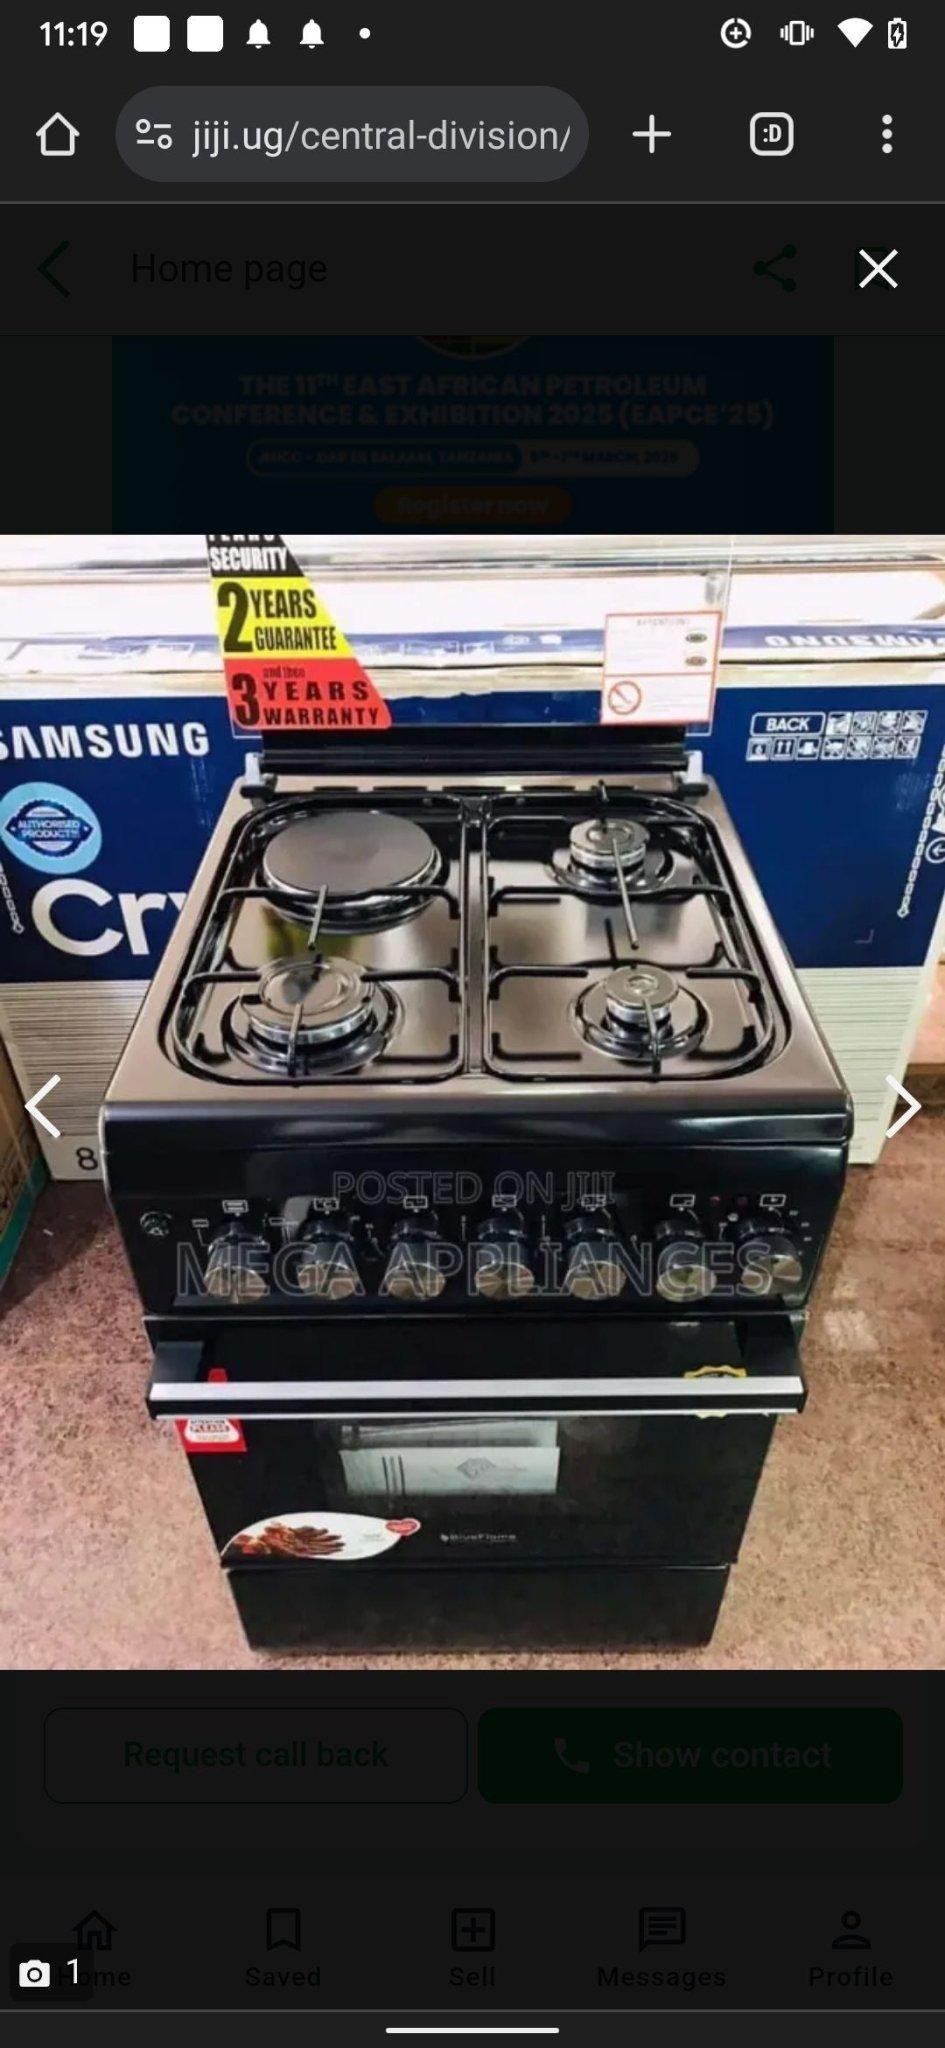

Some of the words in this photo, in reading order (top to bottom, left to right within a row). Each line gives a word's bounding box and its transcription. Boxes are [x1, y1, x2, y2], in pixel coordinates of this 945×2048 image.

[39, 21, 108, 48] 11:19
[192, 119, 571, 158] jiji.ug/central-division/
[132, 253, 233, 283] Home
[244, 259, 328, 291] page
[239, 374, 288, 397] THE
[342, 374, 412, 397] EAST
[416, 374, 541, 397] AFRICAN
[545, 374, 707, 397] PETROLEUM
[171, 403, 353, 426] CONFERENCE
[357, 403, 378, 426] &
[384, 403, 544, 426] EXHIBITION
[548, 403, 613, 426] 2025
[210, 546, 288, 571] SECURITY
[217, 581, 253, 653] 2
[249, 588, 317, 618] YEARS
[254, 626, 337, 650] GUARANTEE
[231, 673, 260, 726] 3
[262, 681, 369, 701] YEARS
[262, 707, 379, 726] WARRANTY
[765, 717, 811, 732] BACK
[32, 878, 188, 956] Cr
[76, 1146, 98, 1170] 8
[123, 1740, 246, 1774] Request
[254, 1740, 307, 1768] call
[316, 1740, 389, 1768] back
[613, 1740, 701, 1769] Show
[710, 1742, 833, 1769] contact
[57, 1966, 131, 1987] Home
[66, 1958, 78, 1984] 1
[245, 1967, 321, 1987] Saved
[449, 1966, 496, 1987] Sell
[597, 1967, 727, 1992] Messages
[809, 1966, 894, 1987] Profile
